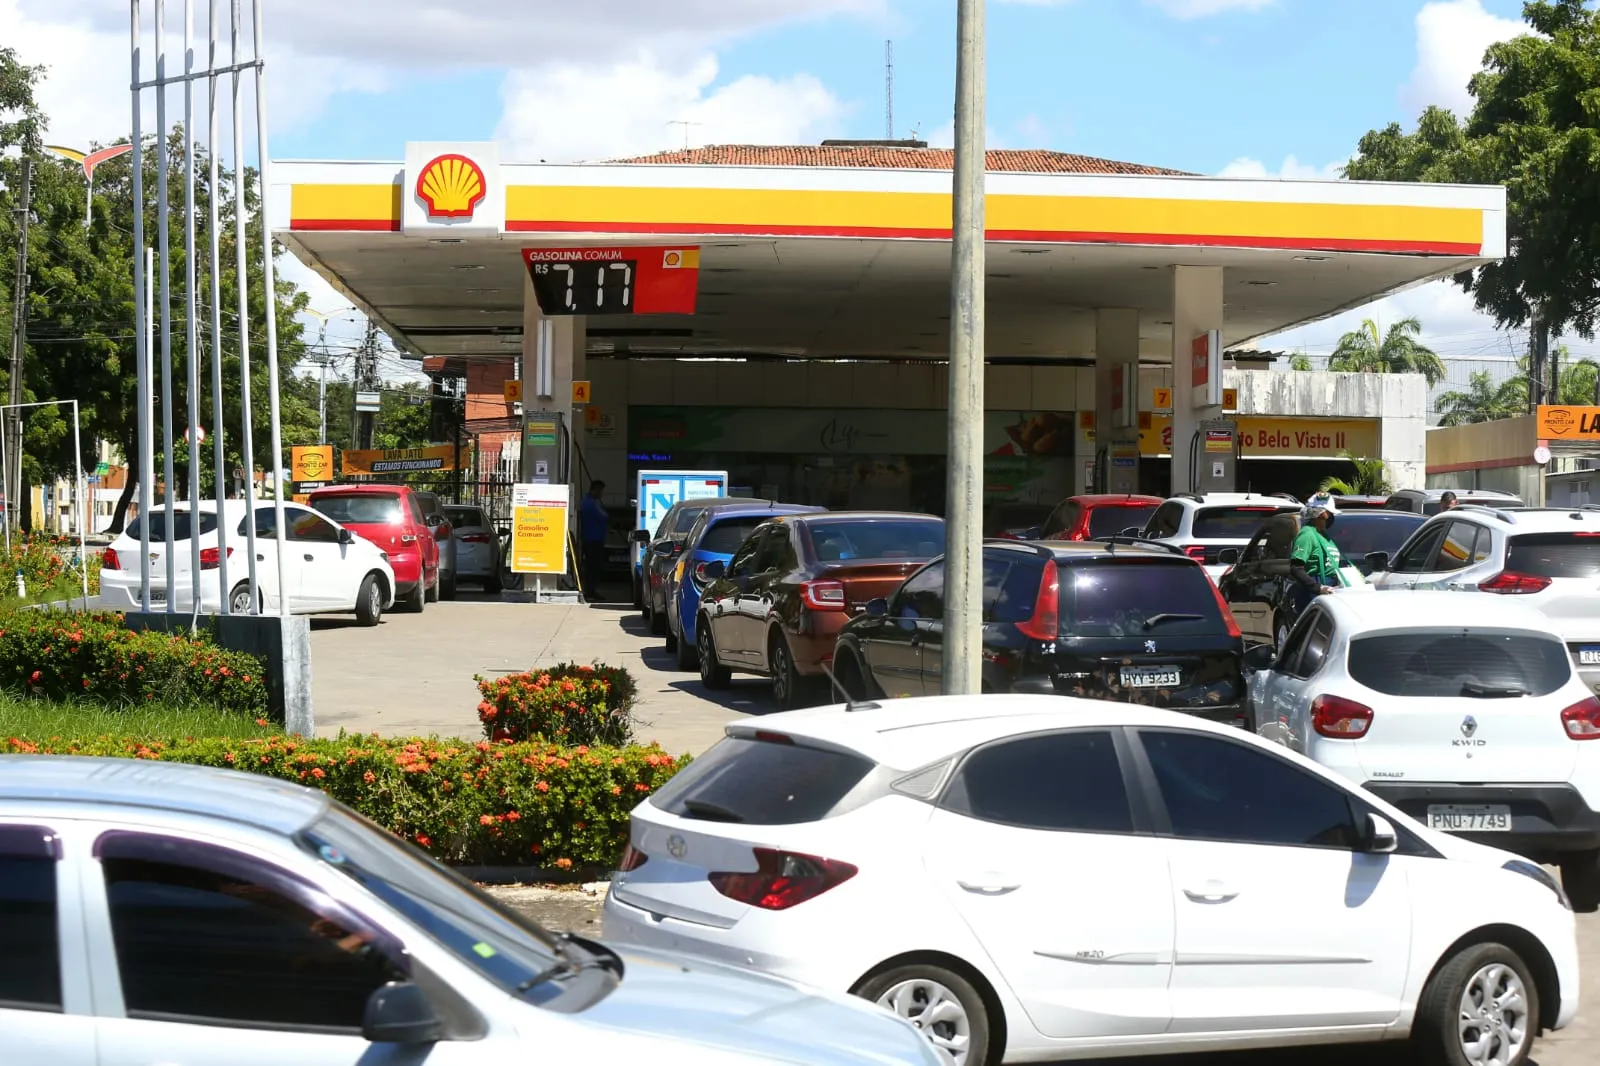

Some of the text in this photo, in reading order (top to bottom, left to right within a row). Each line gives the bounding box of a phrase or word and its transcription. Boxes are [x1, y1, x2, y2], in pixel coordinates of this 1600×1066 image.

[530, 250, 622, 261] GASOLINA COMUM
[535, 263, 631, 310] R$ 7,17
[508, 386, 517, 396] 3
[576, 386, 584, 398] 4
[1158, 392, 1167, 404] 7
[1226, 393, 1232, 404] 8
[1238, 432, 1253, 446] to
[1258, 430, 1290, 448] Bela
[1295, 430, 1330, 448] Vista
[383, 448, 424, 460] LAVA JATO
[374, 460, 441, 470] ESTAMOS FUNCIONANDO
